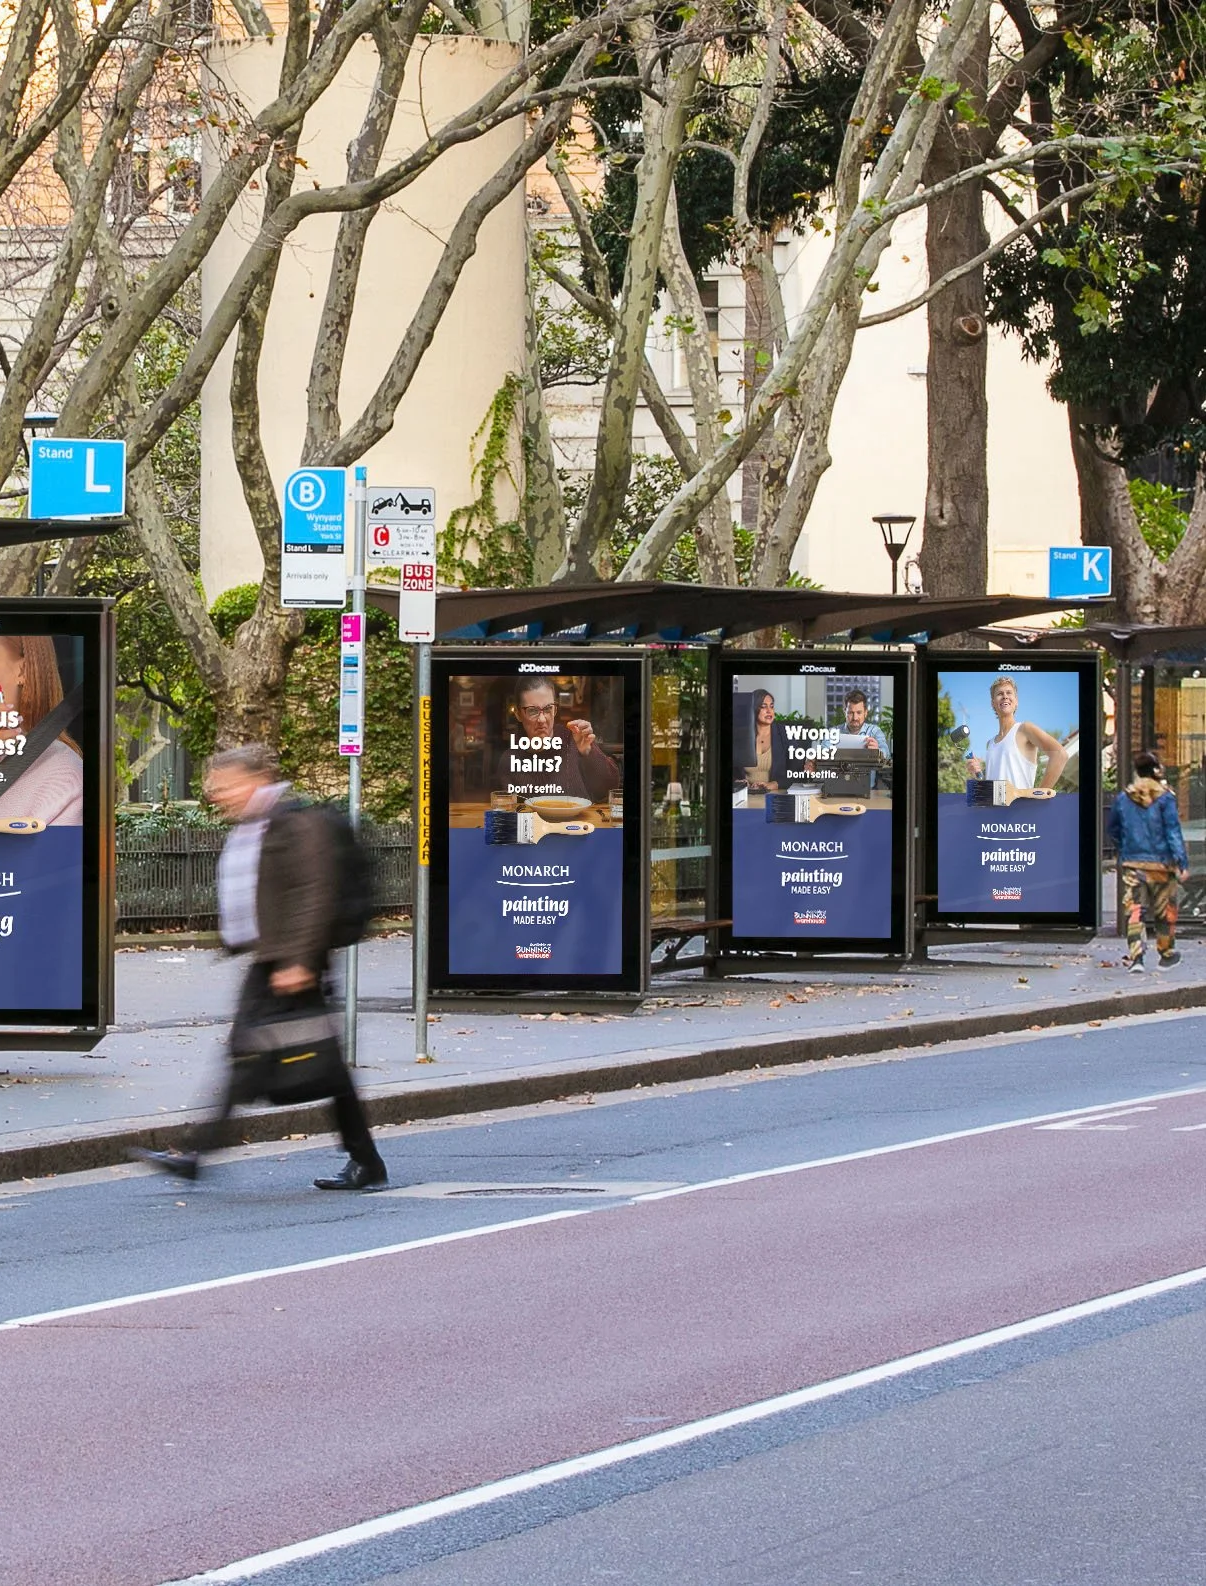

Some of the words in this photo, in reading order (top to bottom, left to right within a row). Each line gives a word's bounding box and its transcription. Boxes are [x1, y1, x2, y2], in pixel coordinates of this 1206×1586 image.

[38, 447, 73, 459] Stand
[85, 448, 111, 492] L
[299, 481, 315, 502] B
[306, 513, 342, 523] Wynyard
[313, 523, 342, 531] Station
[377, 528, 387, 545] C
[286, 544, 307, 552] Stand
[308, 544, 313, 552] L
[1053, 551, 1077, 560] Stand
[405, 565, 432, 577] BUS
[1082, 552, 1103, 581] K
[403, 579, 433, 590] ZONE
[519, 664, 559, 672] JCDecaux
[785, 725, 841, 744] Wrong
[510, 734, 563, 750] Loose
[787, 745, 838, 760] tools?
[510, 754, 563, 773] hairs?
[786, 770, 810, 779] Don't
[810, 769, 839, 779] settle.
[507, 784, 533, 794] Don't
[534, 784, 565, 794] settle.
[982, 824, 1035, 832] MONARCH
[782, 842, 842, 852] MONARCH
[982, 848, 1035, 866] painting
[503, 866, 569, 876] MONARCH
[782, 869, 842, 887] painting
[792, 886, 810, 894] MADE
[813, 886, 830, 894] EASY
[503, 896, 568, 916] painting
[514, 916, 534, 924] MADE
[537, 916, 556, 924] EASY
[515, 945, 552, 953] BUNNINGS
